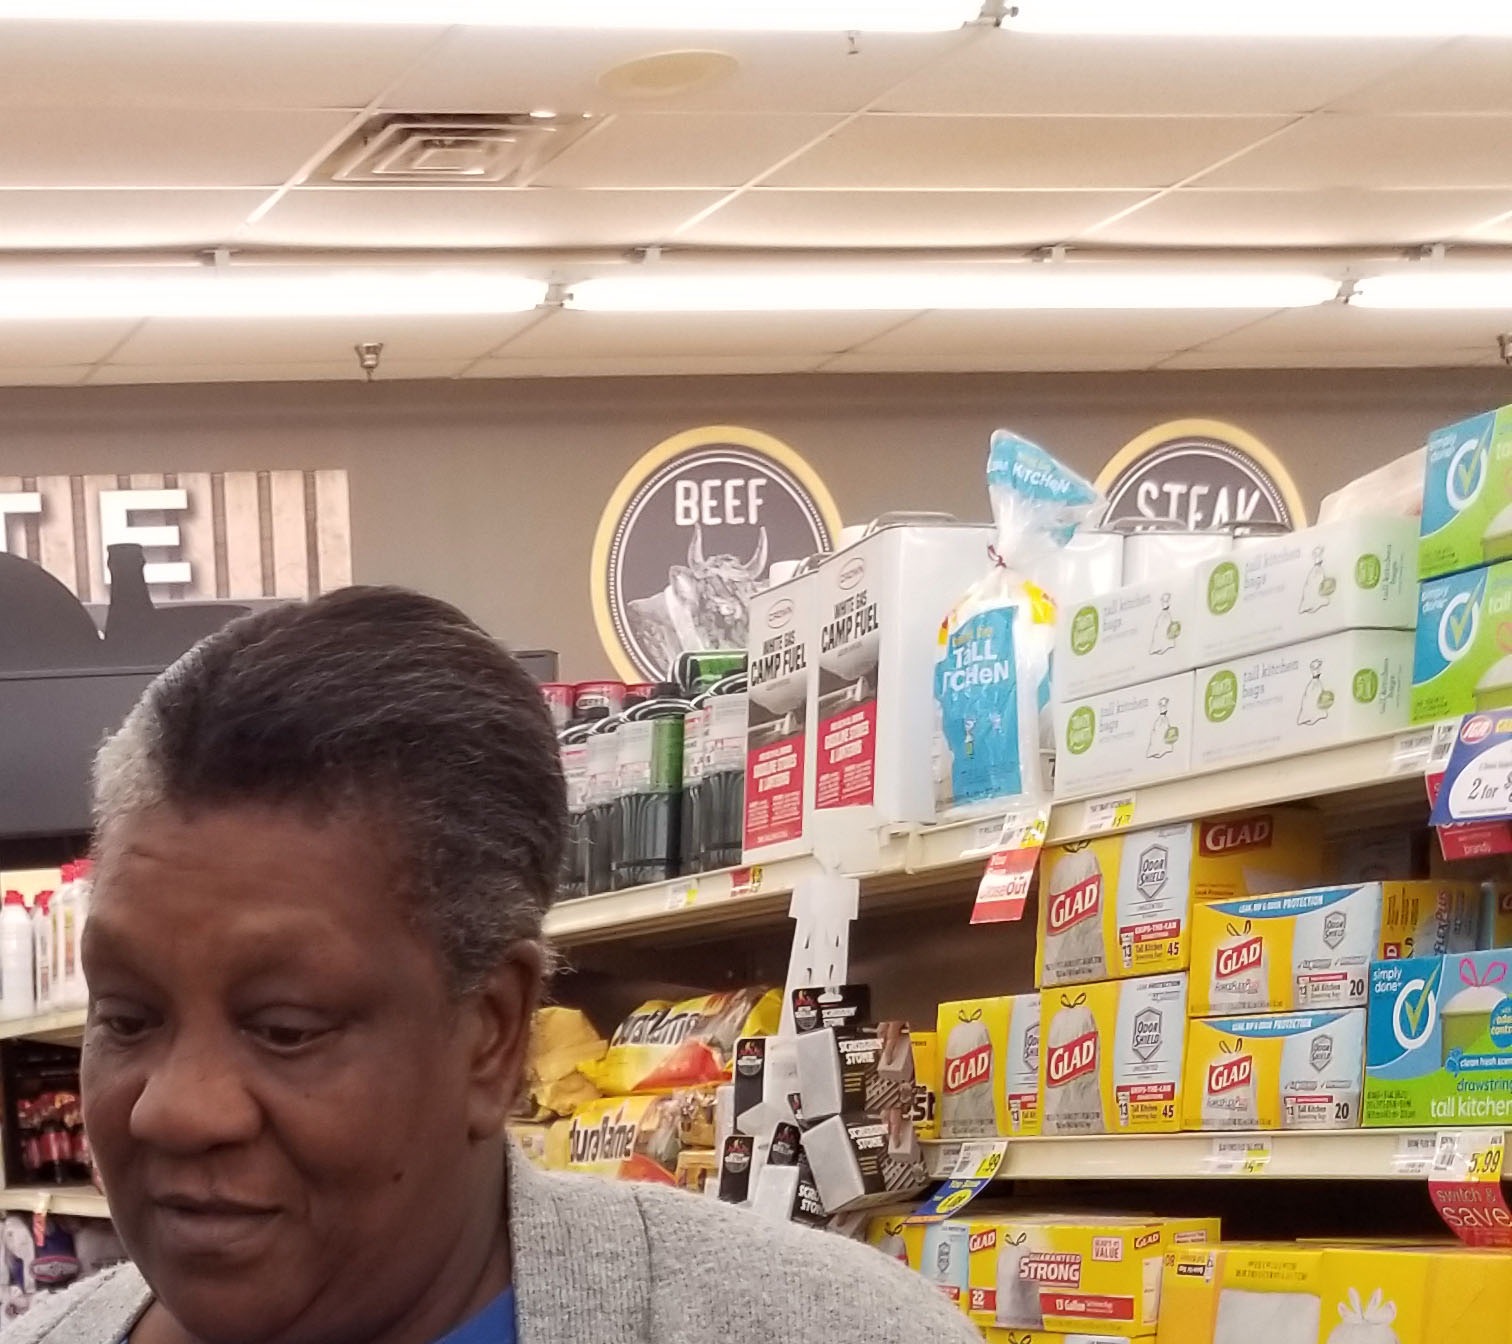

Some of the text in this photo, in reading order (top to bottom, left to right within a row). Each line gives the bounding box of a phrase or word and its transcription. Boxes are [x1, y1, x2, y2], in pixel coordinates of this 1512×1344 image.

[676, 477, 768, 527] BEEF
[1136, 480, 1262, 533] STEAK
[820, 602, 879, 654] CAMP FUEL
[750, 643, 807, 687] CAMP FUEL
[1467, 777, 1500, 801] 2 for
[1205, 821, 1270, 851] GLAD
[1142, 858, 1166, 872] ODOR
[1050, 882, 1099, 929] GLAD
[1122, 944, 1133, 958] 13
[1167, 941, 1180, 957] 45
[1218, 941, 1261, 976] GLAD
[1372, 966, 1403, 983] simply
[1349, 978, 1365, 996] 20
[1374, 979, 1399, 994] done
[1137, 1020, 1159, 1034] ODOR
[1135, 1033, 1160, 1047] SHIELD
[946, 1051, 989, 1090] GLAD
[1049, 1039, 1095, 1082] GLAD
[1211, 1059, 1251, 1092] GLAD
[1118, 1102, 1129, 1116] 13
[1161, 1104, 1175, 1119] 45
[1334, 1102, 1349, 1120] 20
[1430, 1096, 1456, 1118] tall
[1468, 1149, 1501, 1174] 5.99
[1436, 1187, 1482, 1203] switch
[1442, 1206, 1512, 1227] save
[969, 1231, 996, 1252] GLAD
[1135, 1232, 1159, 1248] GLAD
[1029, 1252, 1081, 1263] GUARANTEED
[1094, 1246, 1121, 1260] VALUE
[1019, 1255, 1081, 1281] STRONG
[972, 1290, 985, 1306] 22
